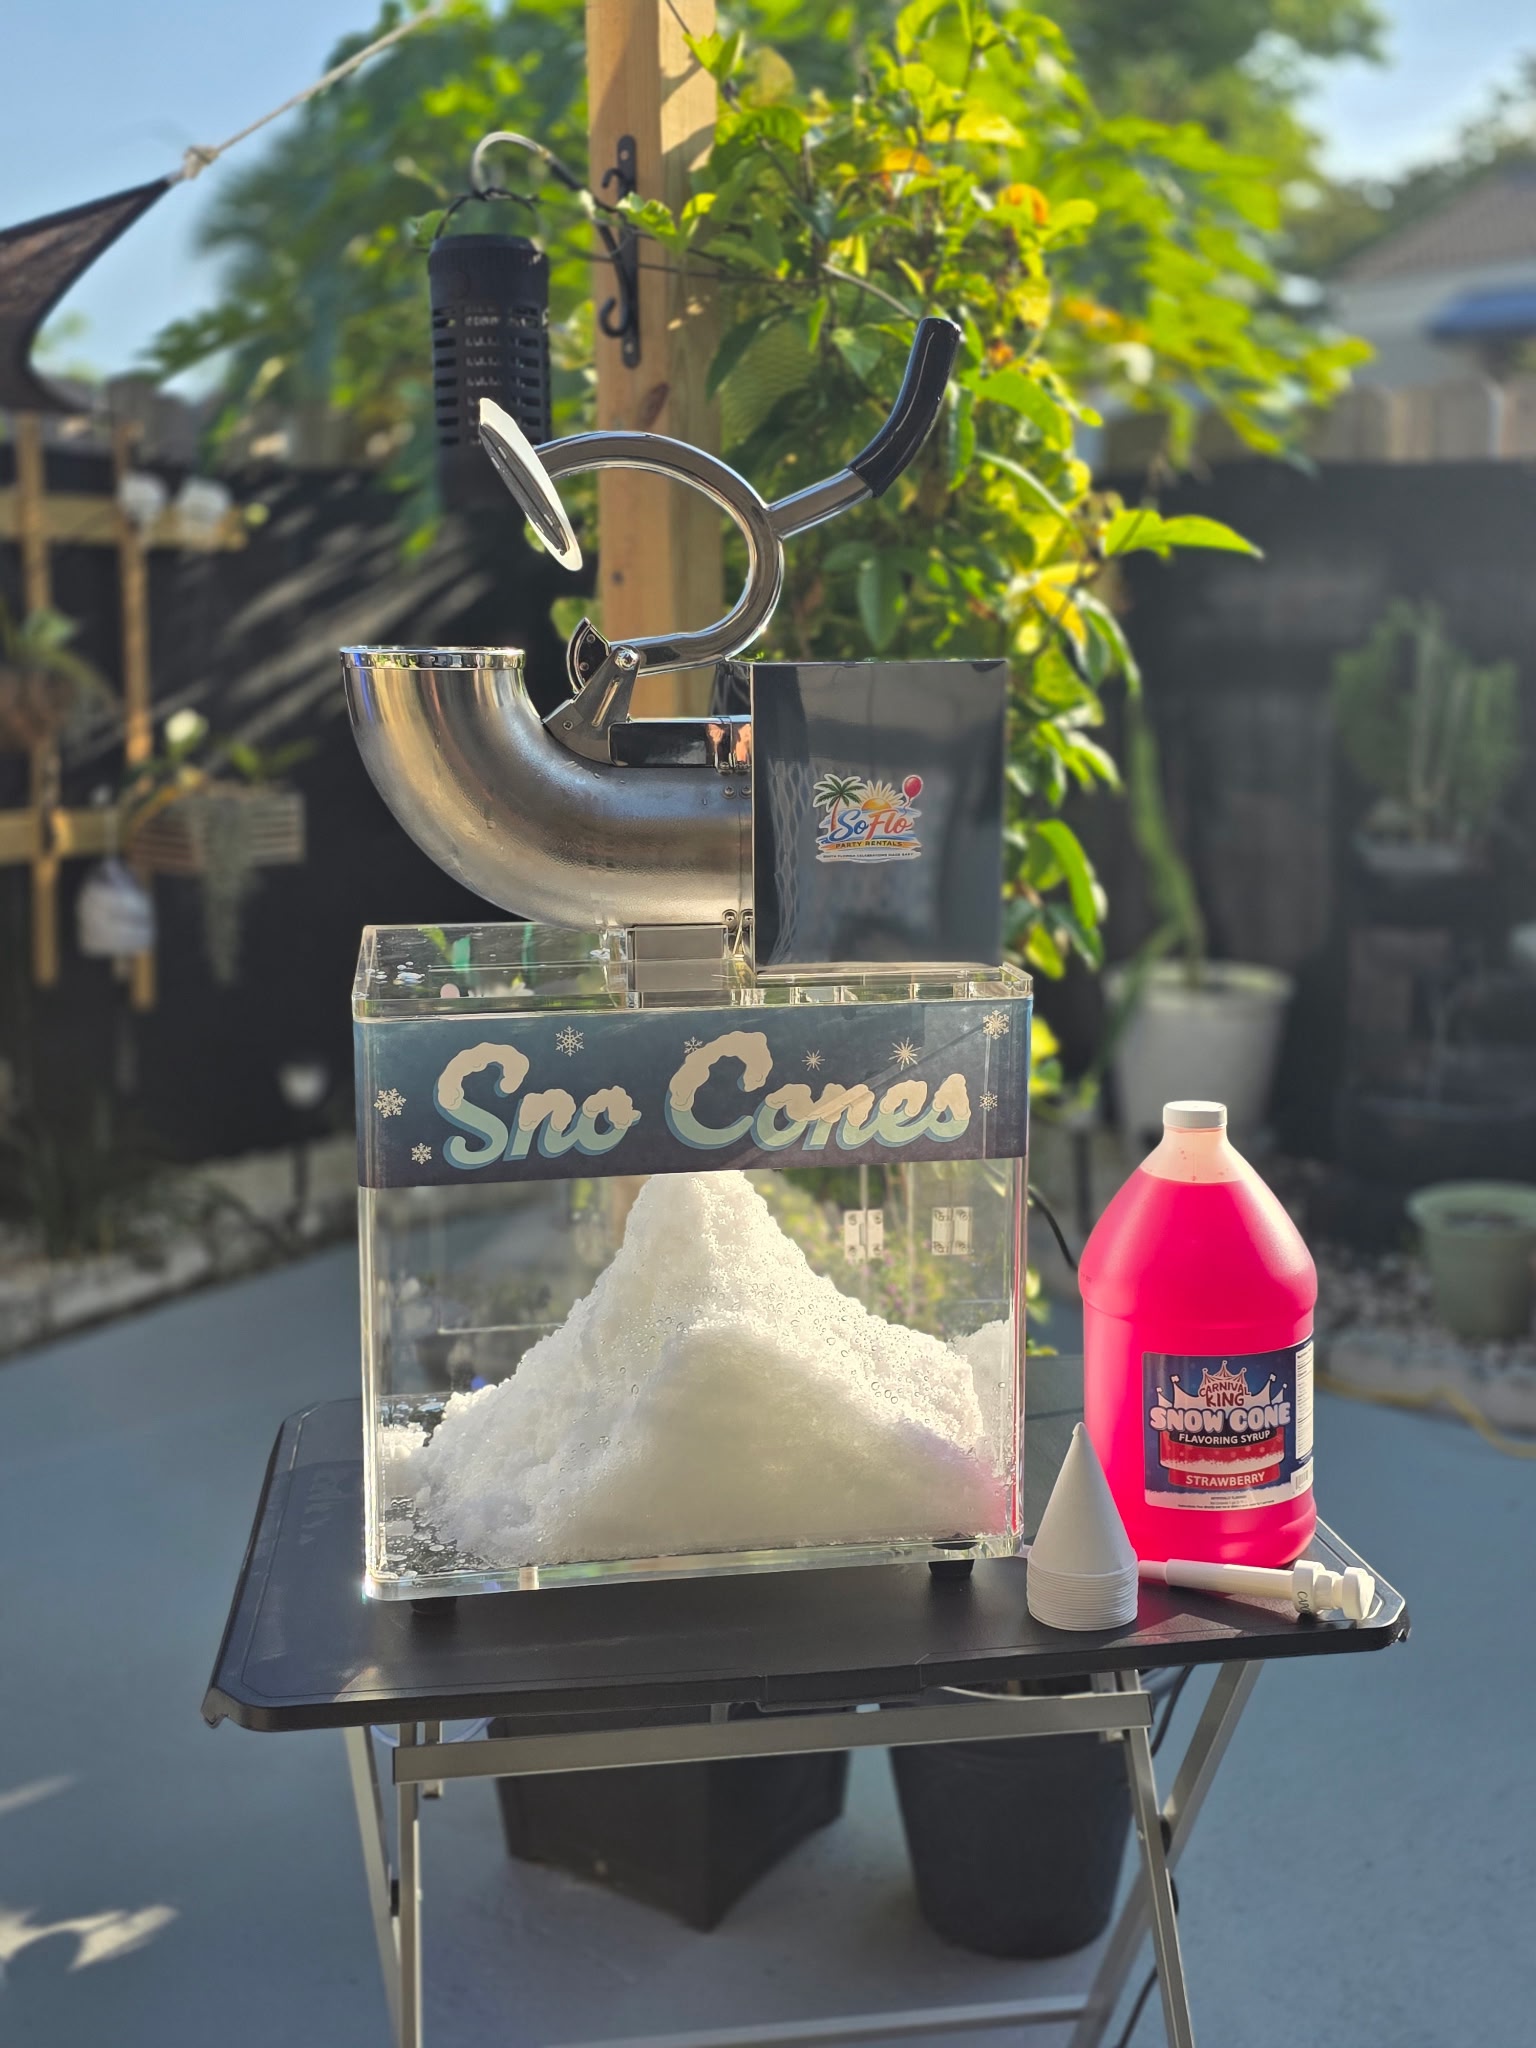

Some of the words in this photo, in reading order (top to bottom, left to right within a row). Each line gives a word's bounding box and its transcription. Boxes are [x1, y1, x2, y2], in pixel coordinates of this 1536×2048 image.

[828, 808, 912, 841] SoFlo
[835, 841, 862, 849] PARTY
[865, 840, 903, 848] RENTALS
[434, 1042, 641, 1171] Sno
[665, 1030, 971, 1155] Cones
[1200, 1382, 1251, 1397] CARNIVAL
[1206, 1393, 1245, 1407] KING
[1150, 1406, 1226, 1432] SNOW
[1229, 1401, 1291, 1431] CONE
[1178, 1434, 1238, 1445] FLAVORING
[1241, 1430, 1271, 1444] SYRUP
[1186, 1472, 1266, 1487] STRAWBERRY
